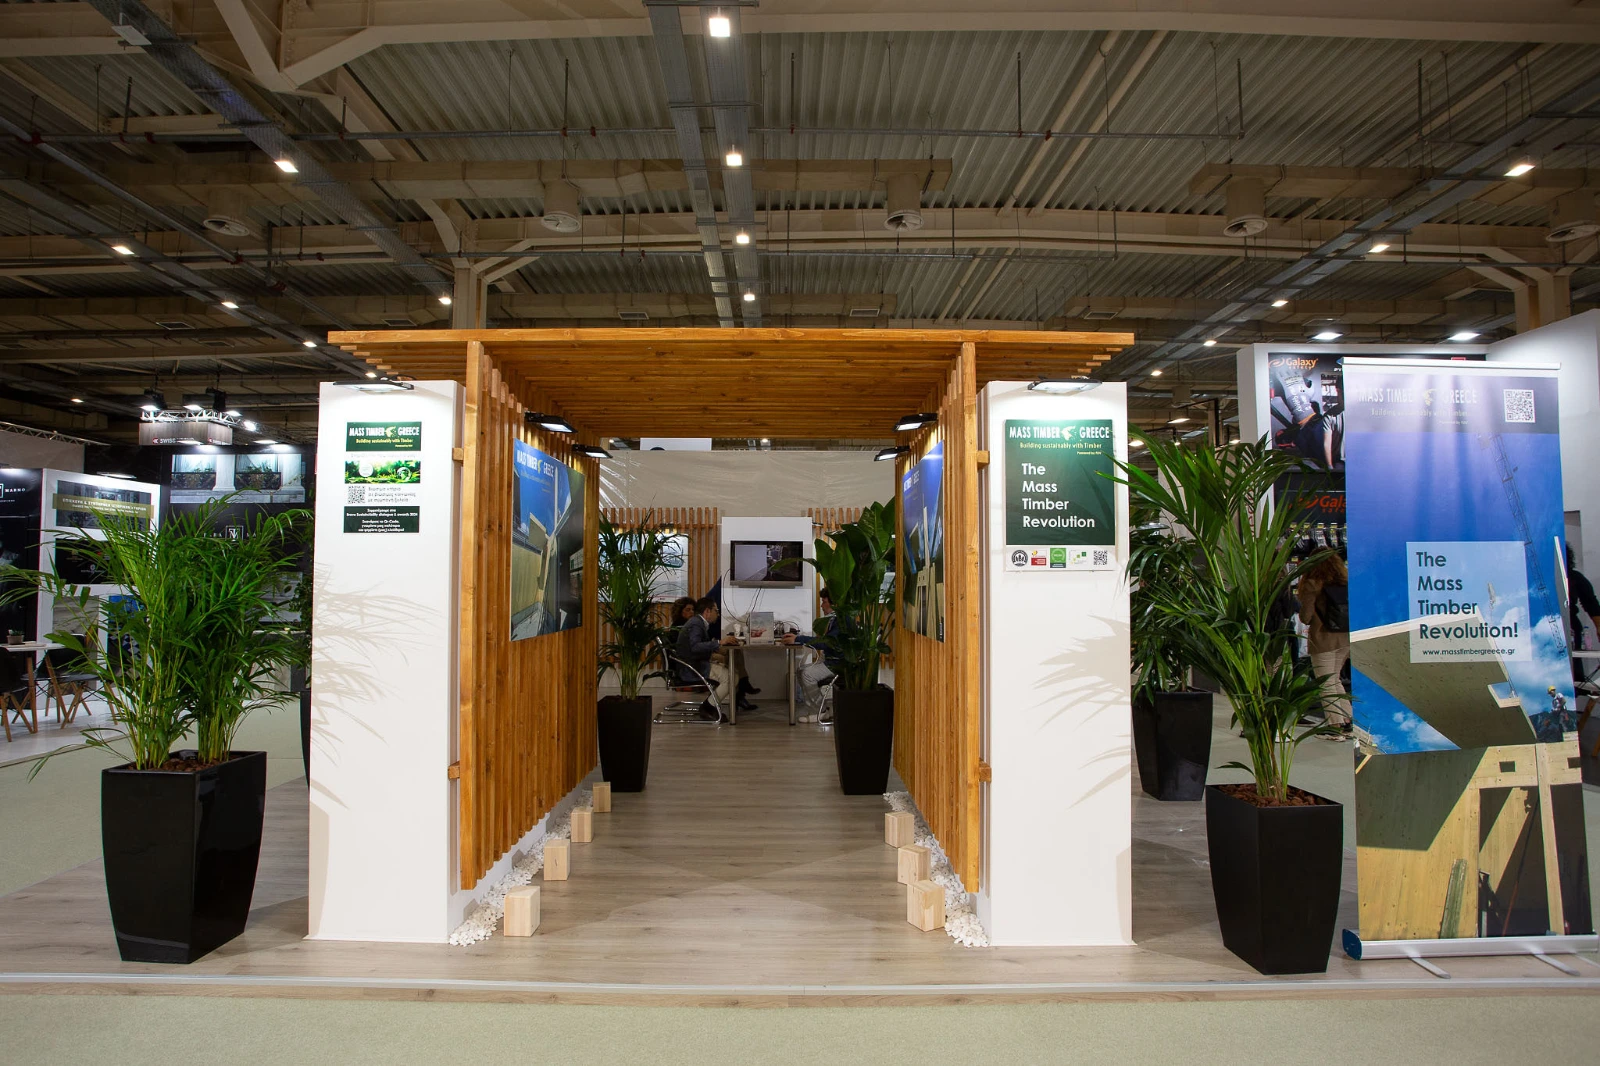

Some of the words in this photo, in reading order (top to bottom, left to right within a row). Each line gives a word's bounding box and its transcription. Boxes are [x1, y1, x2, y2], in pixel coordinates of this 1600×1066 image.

[1285, 357, 1317, 368] Galaxy
[1360, 388, 1384, 402] MASS
[1386, 388, 1416, 403] TIMBE
[349, 427, 365, 437] MASS
[366, 427, 385, 437] TIMBER
[398, 426, 420, 436] GREECE
[1009, 426, 1032, 439] MASS
[1033, 426, 1061, 439] TIMBER
[1080, 426, 1110, 439] GREECE
[1020, 442, 1041, 450] Building
[1042, 442, 1072, 450] sustainably
[1022, 463, 1046, 475] The
[1022, 481, 1058, 493] Mass
[1022, 498, 1069, 510] Timber
[1022, 515, 1096, 528] Revolution
[1415, 551, 1447, 568] The
[1417, 575, 1463, 591] Mass
[1417, 599, 1478, 615] Timber
[1419, 622, 1519, 639] Revolution!
[1422, 647, 1516, 659] www.masstimbergreece.gr
